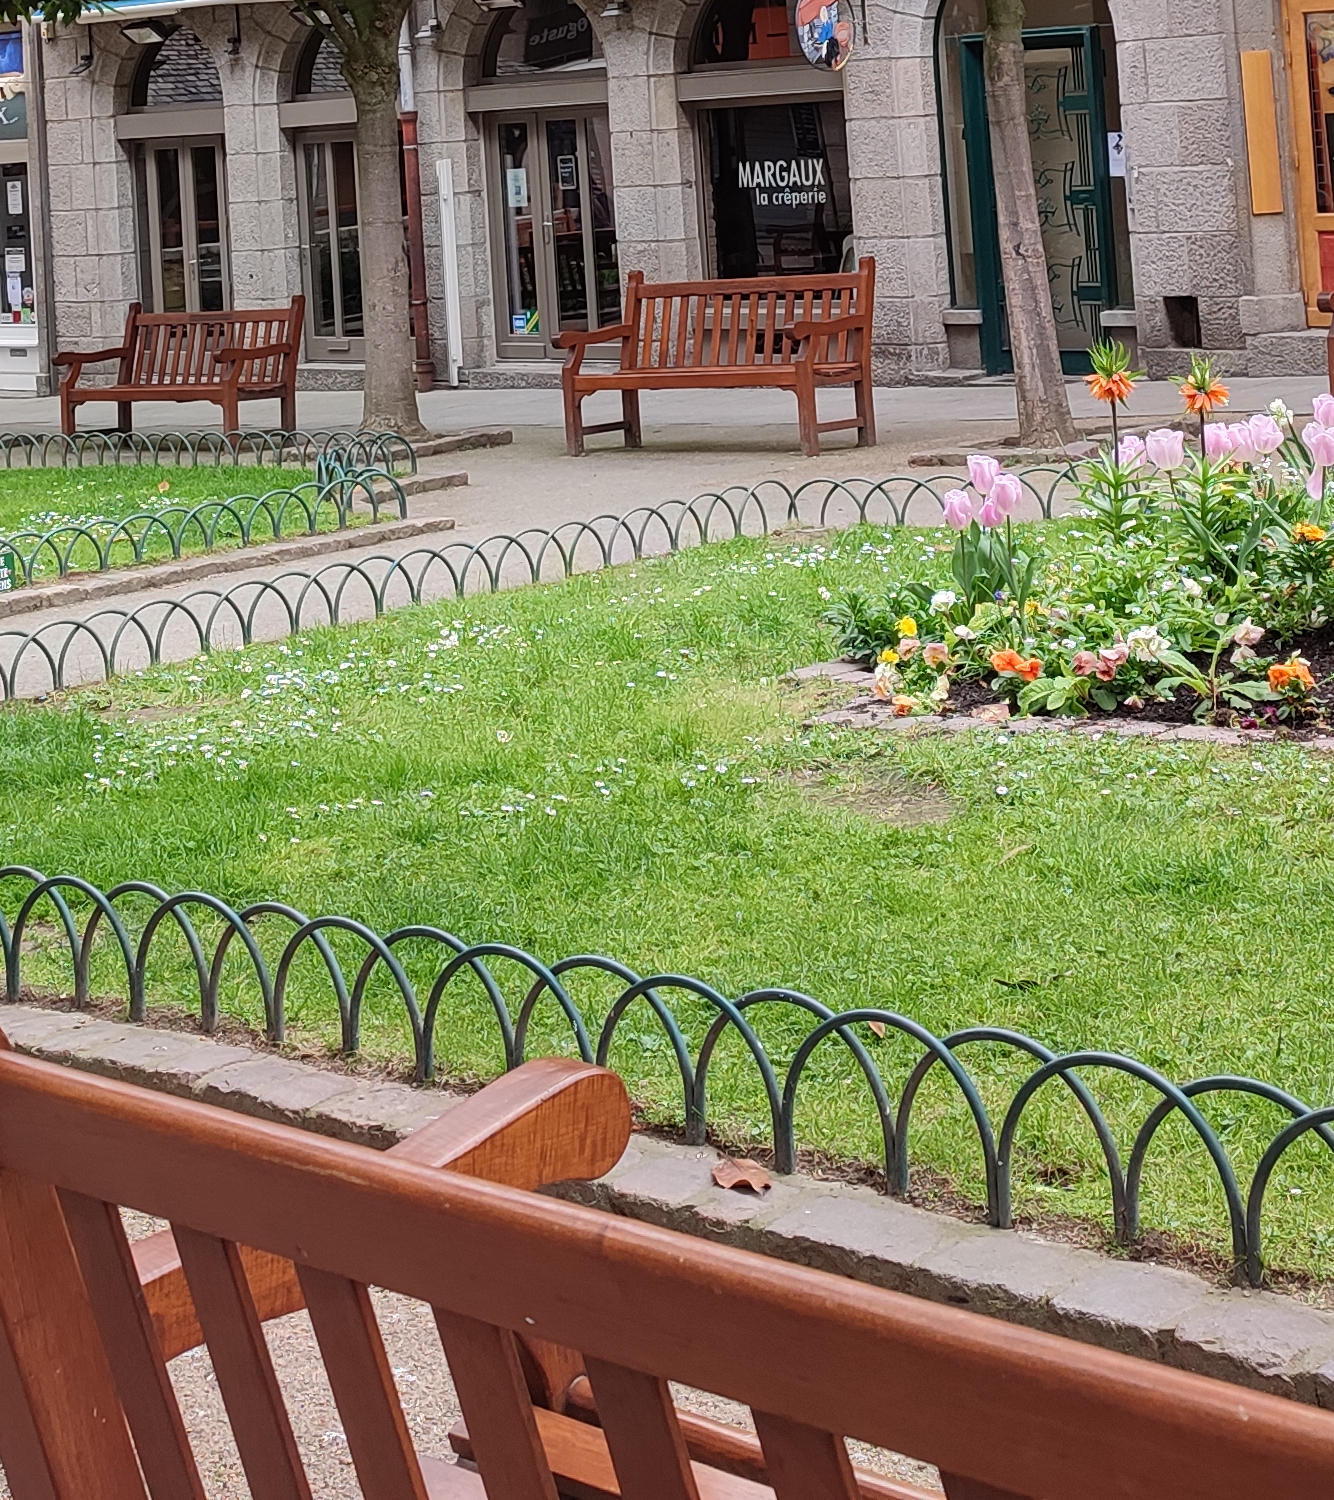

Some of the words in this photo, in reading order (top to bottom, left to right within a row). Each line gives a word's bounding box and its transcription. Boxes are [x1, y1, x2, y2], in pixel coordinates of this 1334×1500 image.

[738, 158, 825, 188] MARGAUX
[755, 187, 768, 205] la
[772, 186, 826, 208] crêperie
